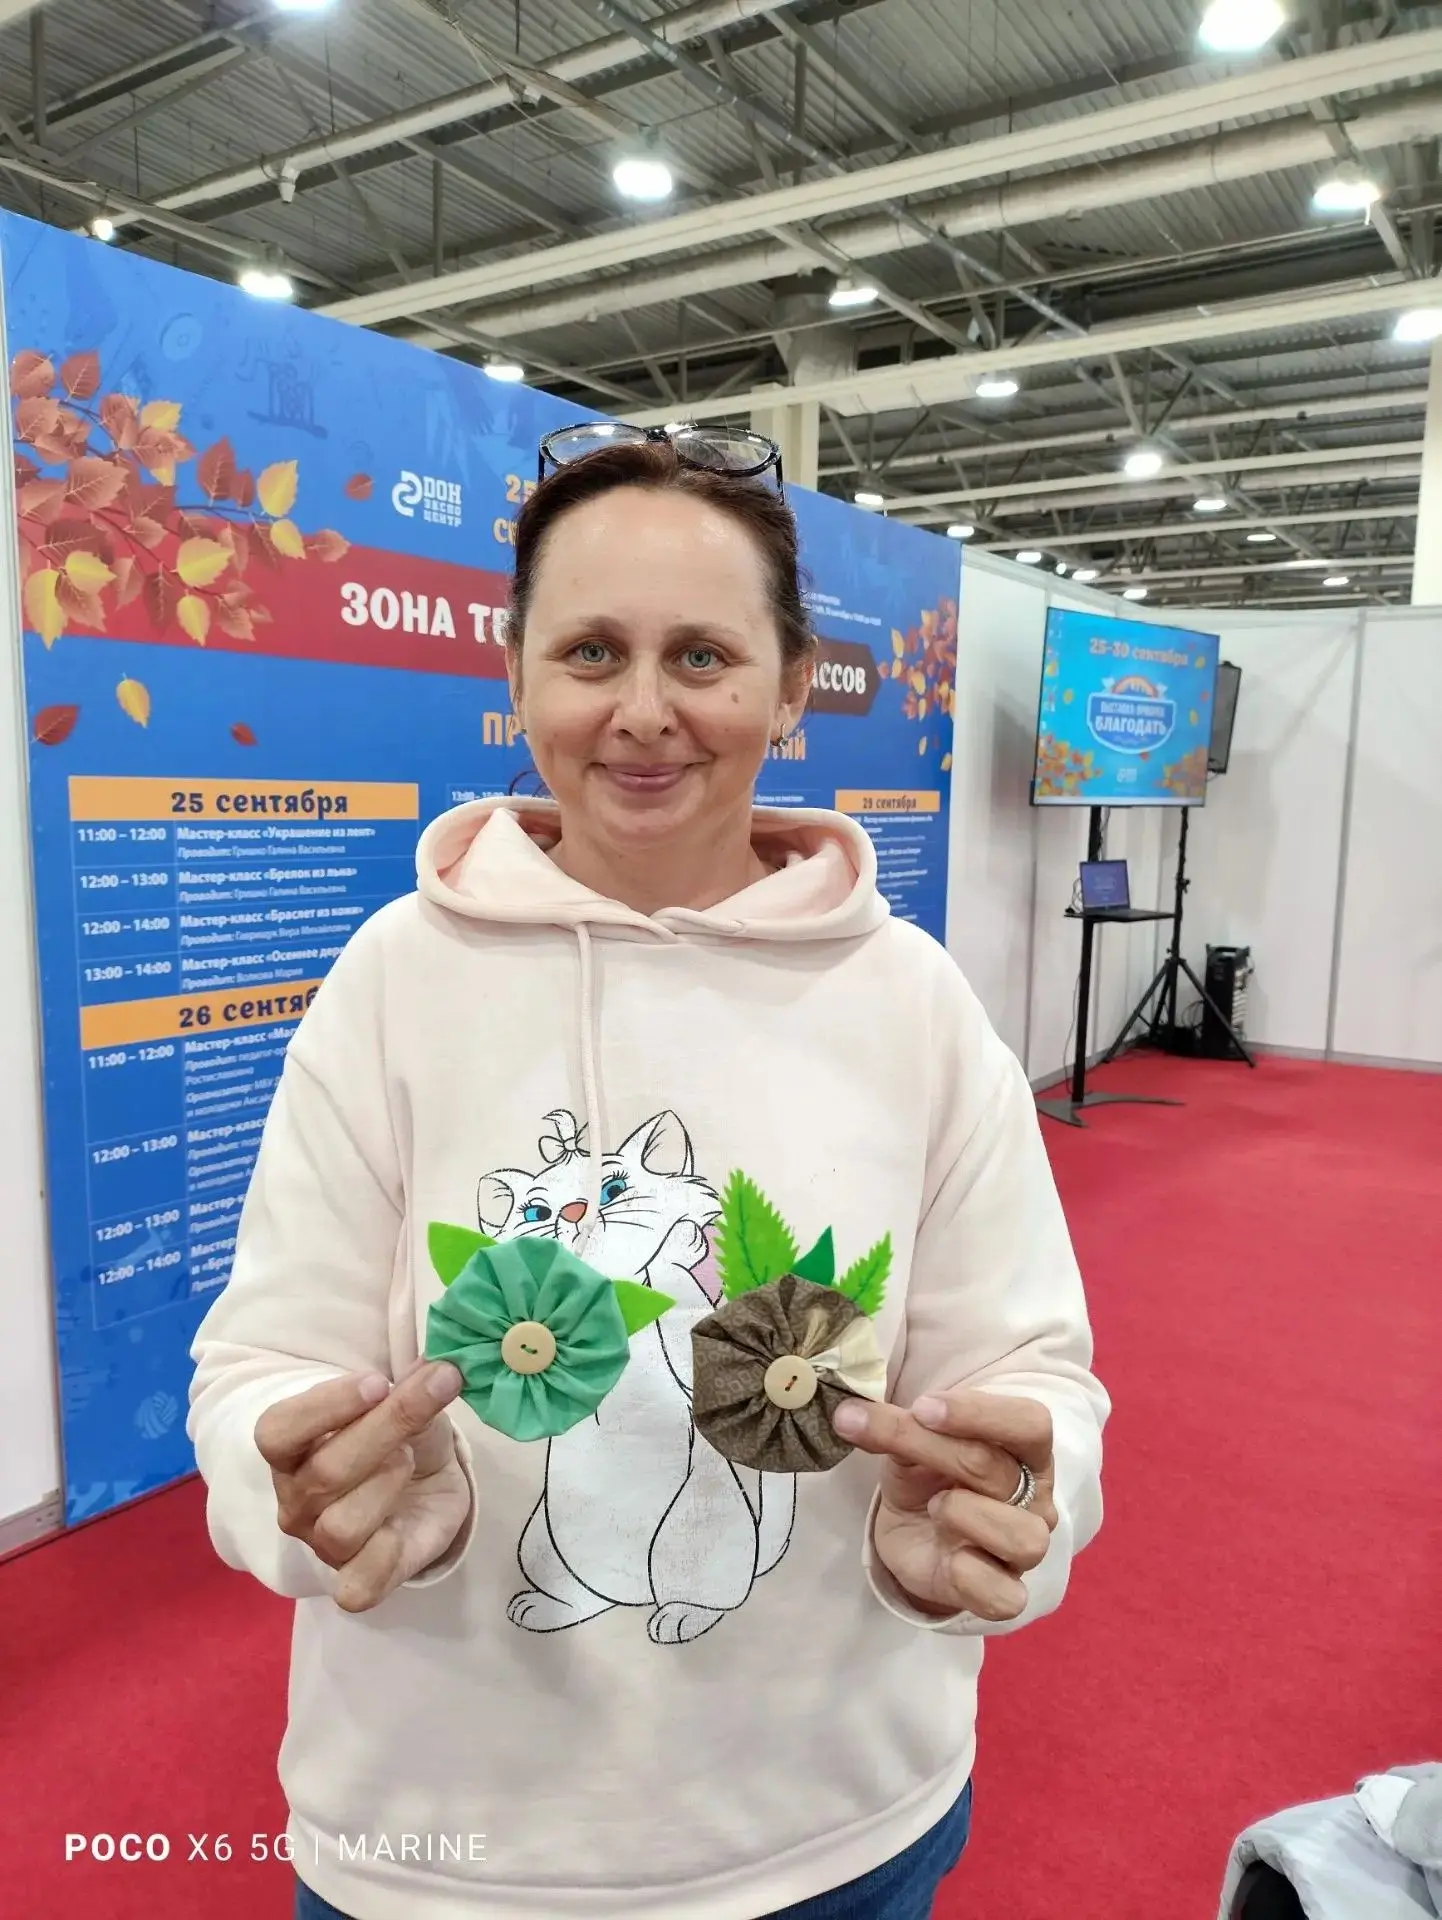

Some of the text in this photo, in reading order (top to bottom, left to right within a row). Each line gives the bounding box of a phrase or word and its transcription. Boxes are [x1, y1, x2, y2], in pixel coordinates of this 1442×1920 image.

[341, 582, 456, 639] ЗОНА
[1095, 715, 1167, 737] БЛАГОДАТЬ
[171, 788, 348, 819] 25 сентября
[78, 828, 117, 842] 11:00
[129, 827, 166, 841] 12:00
[177, 827, 261, 842] Мастер-класс
[80, 874, 118, 889] 12:00
[131, 872, 168, 887] 13:00
[178, 871, 262, 886] Мастер-класс
[82, 920, 121, 936] 12:00
[133, 917, 170, 932] 14:00
[180, 912, 263, 928] Мастер-класс
[265, 907, 316, 923] «Браслет
[182, 953, 264, 971] Мастер-класс
[265, 947, 319, 962] «Осеннее
[84, 966, 123, 982] 13:00
[135, 961, 172, 977] 14:00
[179, 1005, 211, 1028] 26
[185, 1032, 266, 1053] Мастер-класс
[88, 1051, 126, 1069] 11:00
[138, 1044, 175, 1061] 12:00
[93, 1145, 130, 1164] 12:00
[142, 1135, 178, 1153] 13:00
[96, 1221, 133, 1241] 12:00
[145, 1209, 180, 1228] 13:00
[98, 1264, 135, 1285] 12:00
[146, 1251, 181, 1271] 14:00
